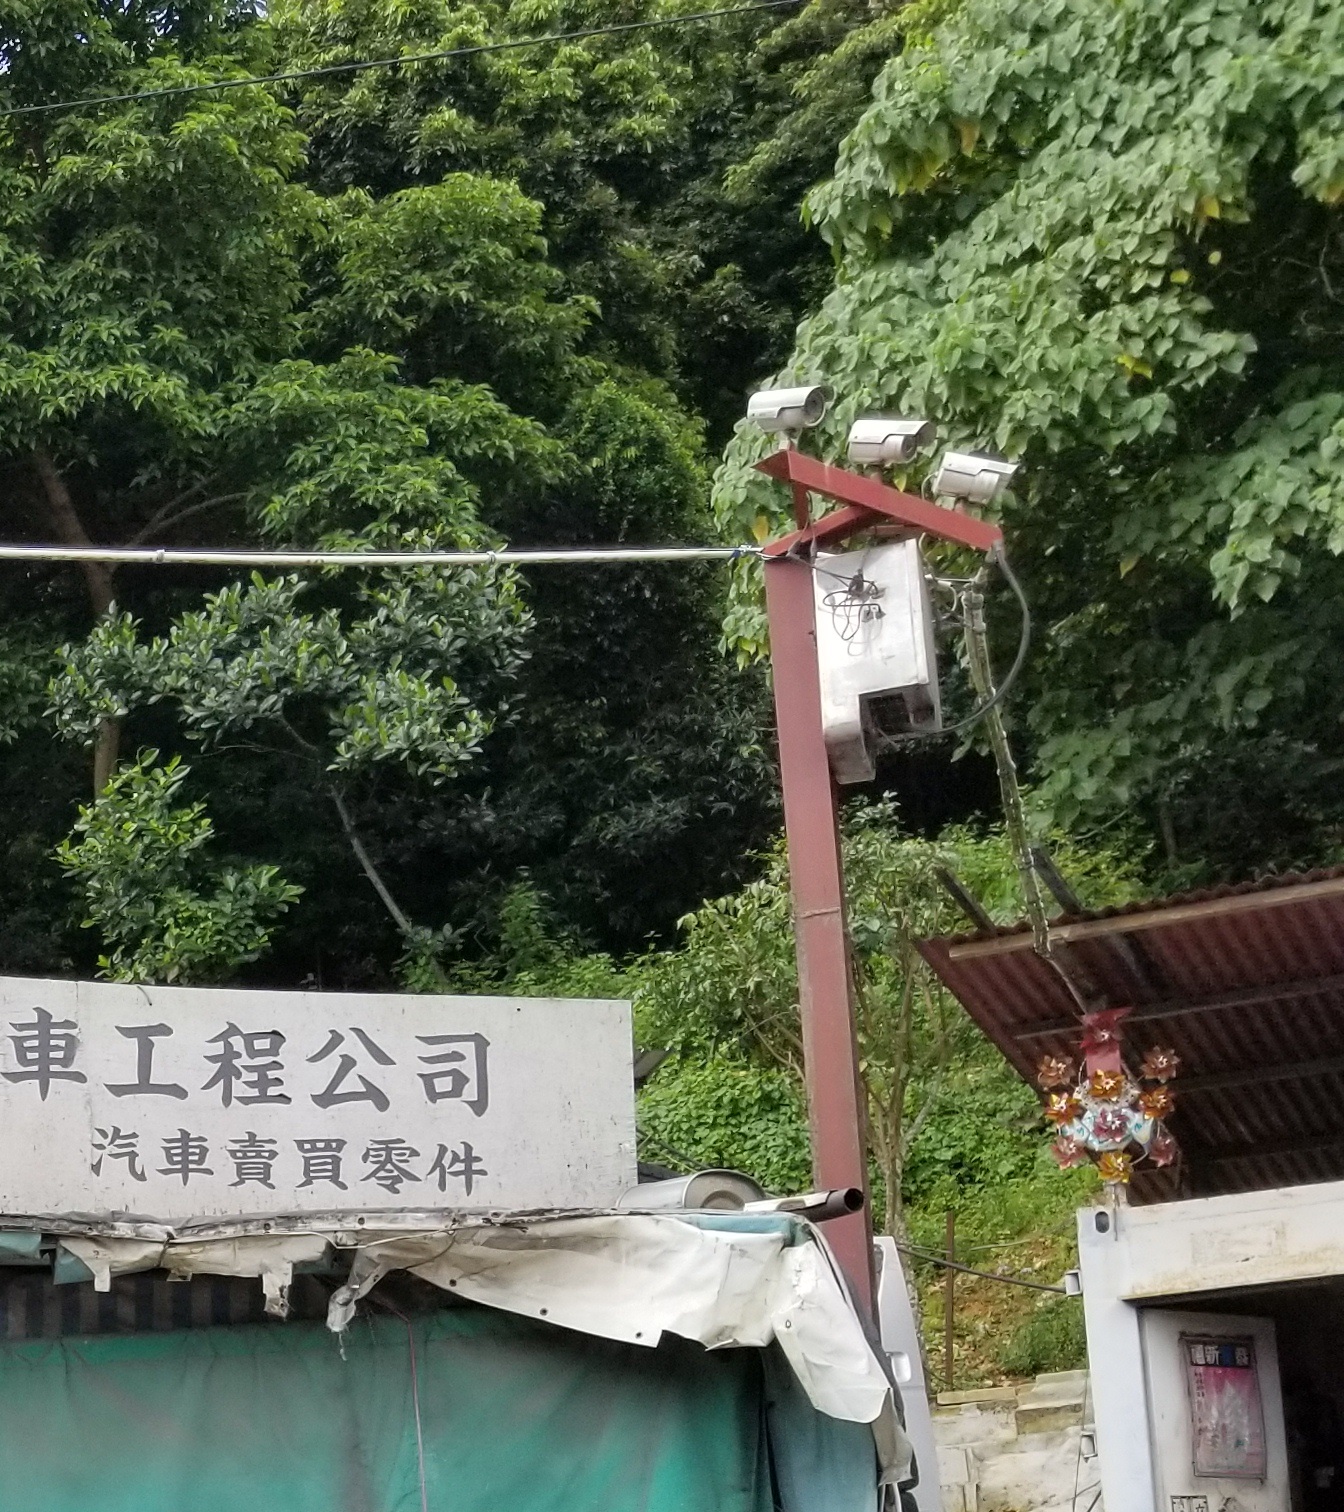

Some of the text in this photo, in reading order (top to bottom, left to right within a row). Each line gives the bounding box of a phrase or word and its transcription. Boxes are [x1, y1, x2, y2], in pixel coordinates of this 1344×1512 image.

[91, 1125, 489, 1197] 汽車賣買零件
